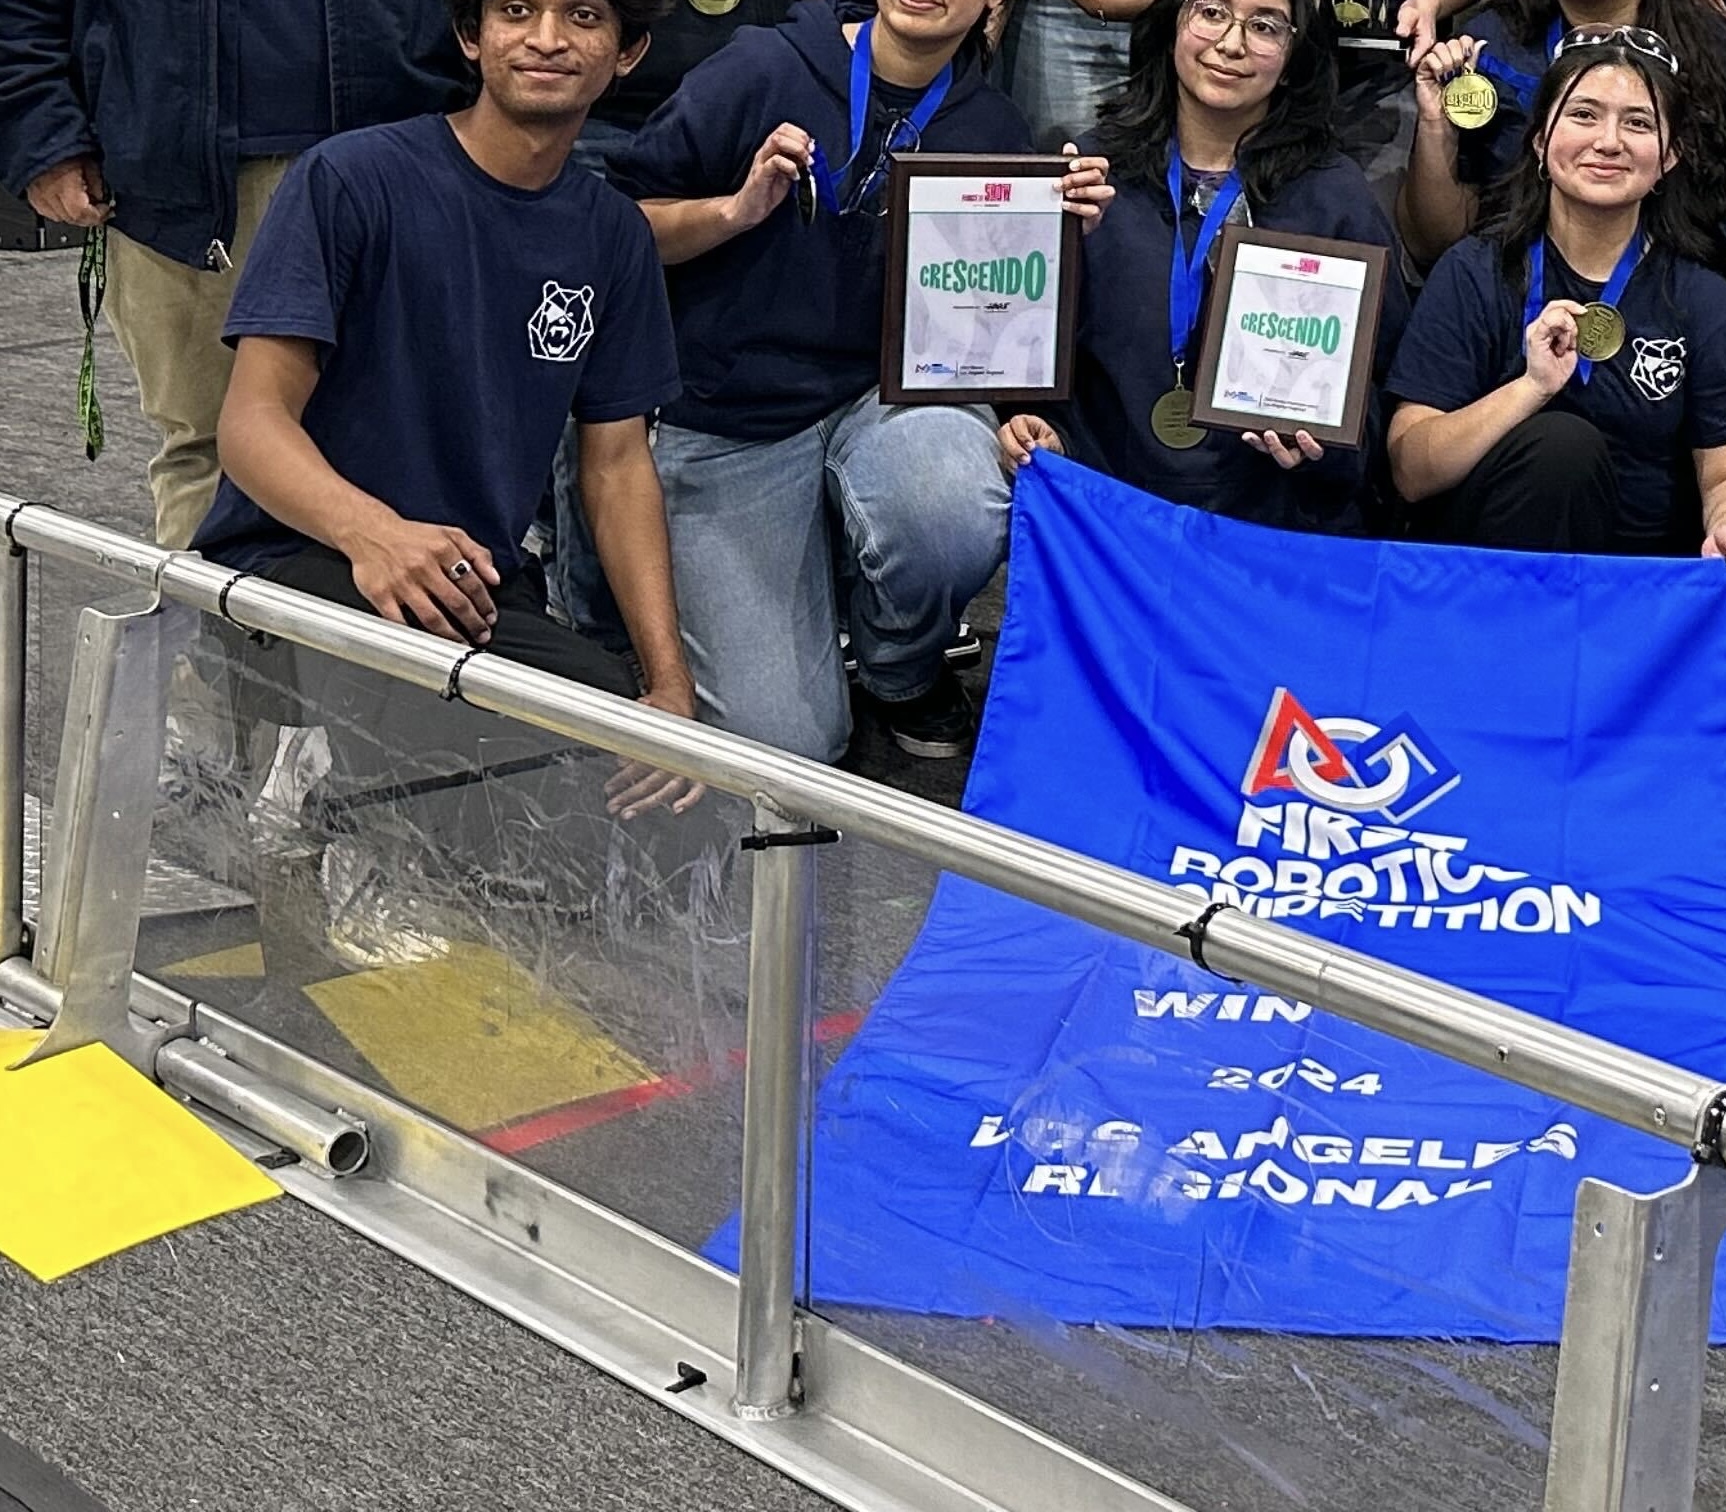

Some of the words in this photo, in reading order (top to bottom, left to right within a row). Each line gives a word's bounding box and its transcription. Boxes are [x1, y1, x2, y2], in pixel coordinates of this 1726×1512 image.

[919, 250, 1046, 302] CRESCENDO
[1240, 313, 1342, 355] CRESCENDO
[1133, 989, 1313, 1023] WIN
[1207, 1057, 1382, 1095] 2024
